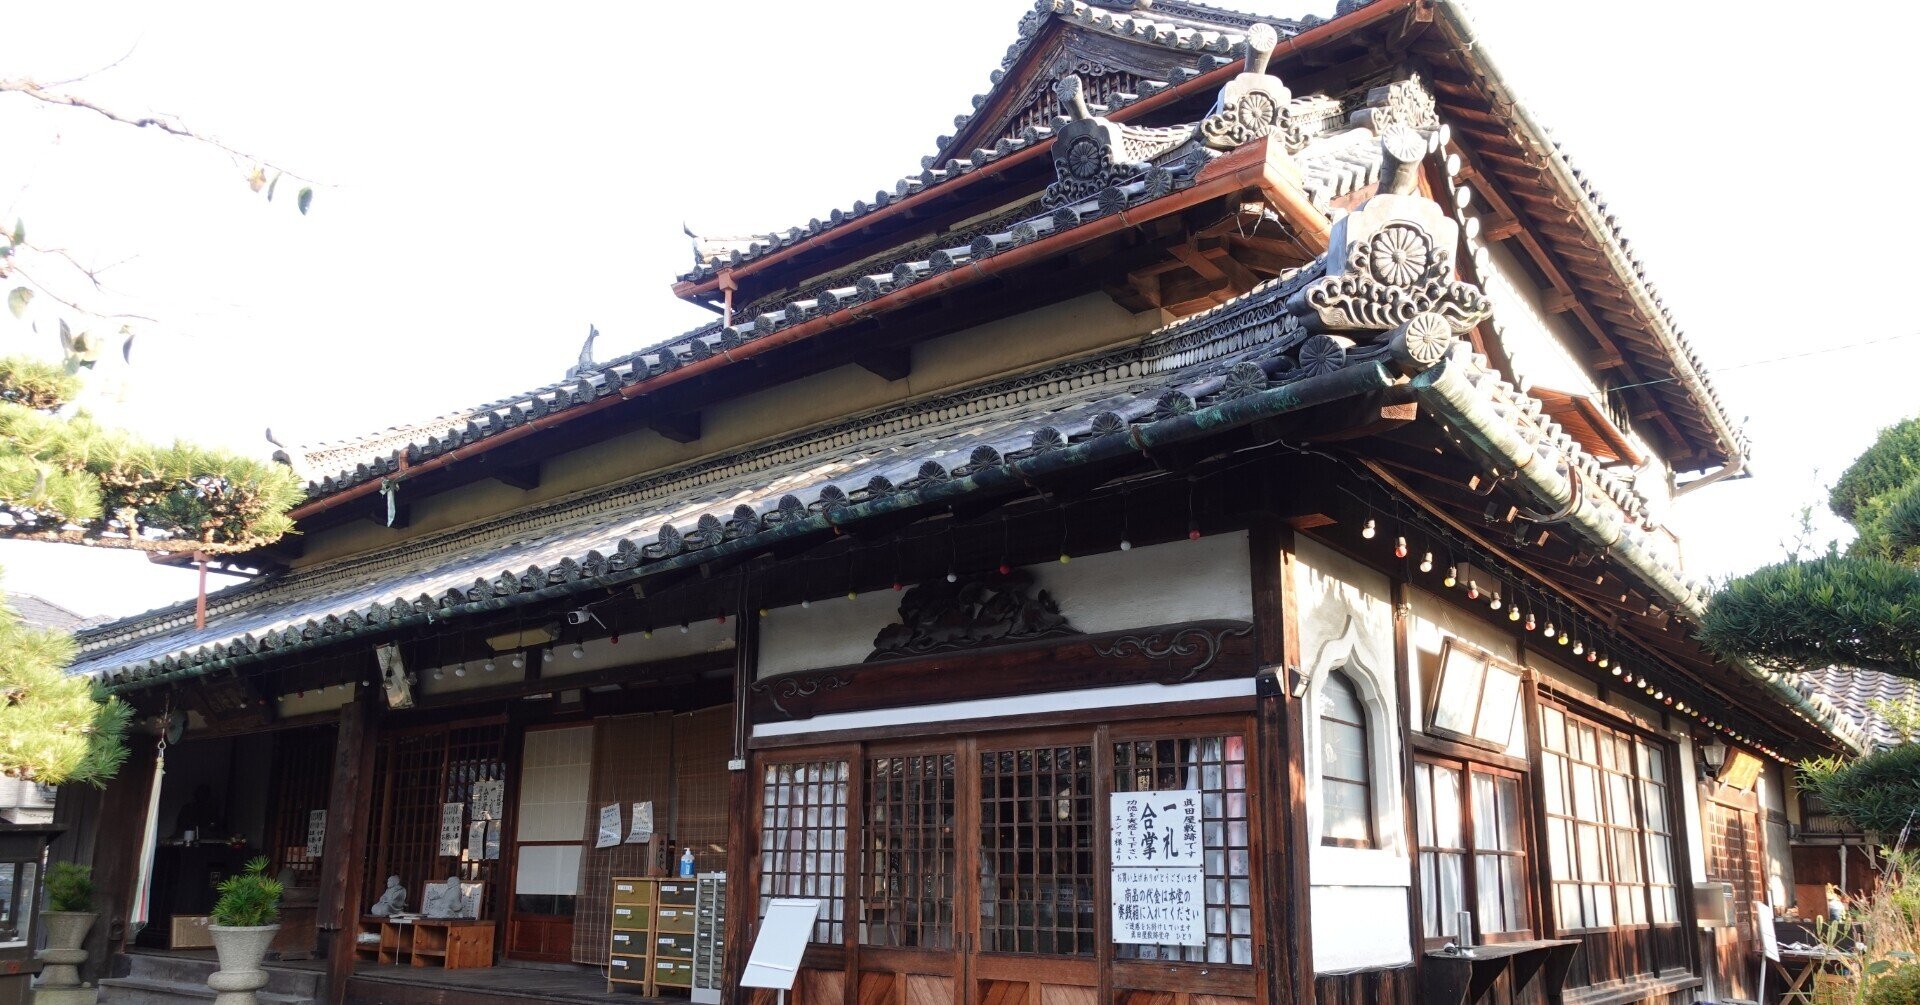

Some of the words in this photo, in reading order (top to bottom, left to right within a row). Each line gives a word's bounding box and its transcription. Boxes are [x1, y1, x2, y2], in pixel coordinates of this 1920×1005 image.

[1115, 815, 1123, 861] エンマ様より
[1140, 802, 1159, 861] 合掌
[1162, 803, 1179, 860] 一礼
[1117, 872, 1198, 884] お買い上げありがとうございます
[1124, 887, 1191, 904] 商品の代金は本堂の
[1118, 904, 1200, 921] 賽銭箱に入れてください
[1125, 922, 1191, 932] ご迷惑をお掛けしています
